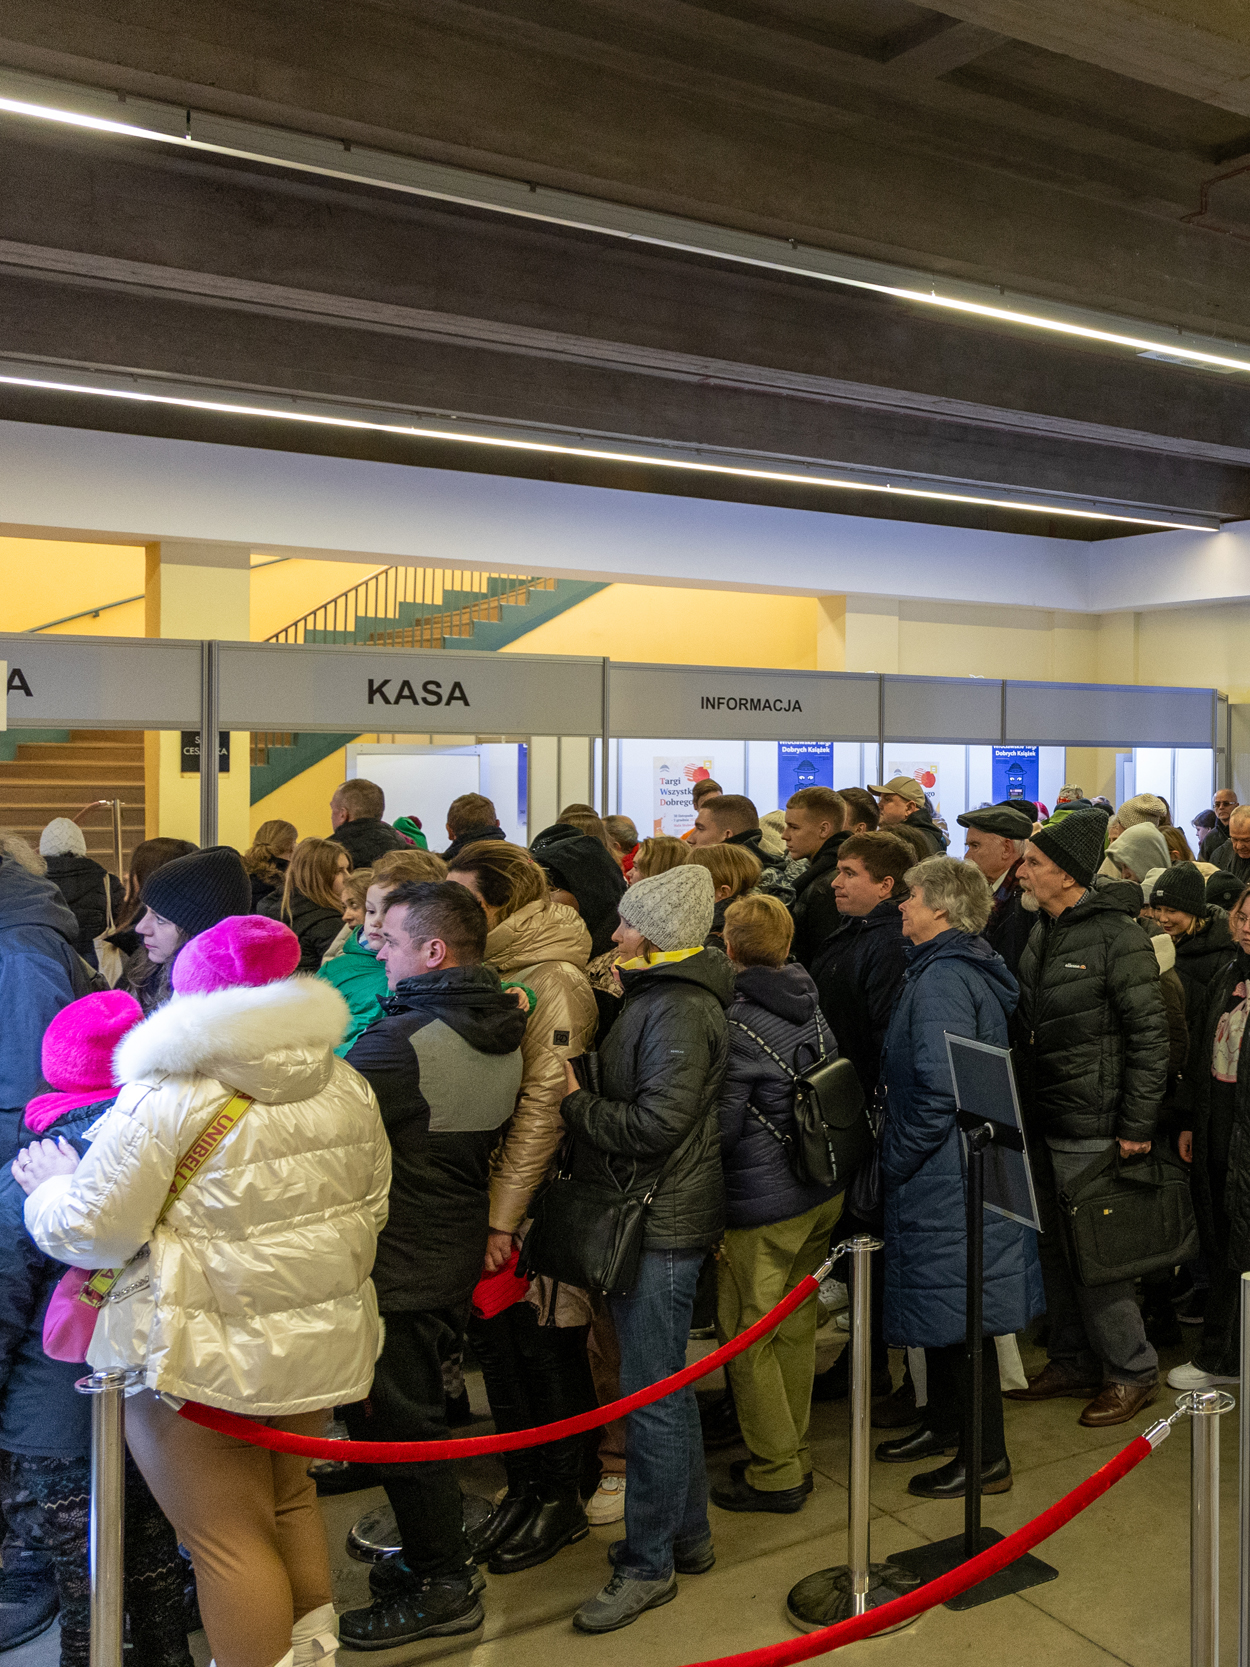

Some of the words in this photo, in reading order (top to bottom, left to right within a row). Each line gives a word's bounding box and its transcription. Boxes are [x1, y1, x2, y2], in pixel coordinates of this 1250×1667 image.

[367, 678, 470, 707] KASA
[700, 695, 803, 714] INFORMACJA
[782, 746, 807, 754] Dobrych
[659, 777, 681, 786] Targi
[659, 787, 693, 797] Wszystk
[169, 1114, 234, 1194] UNIBELLA
